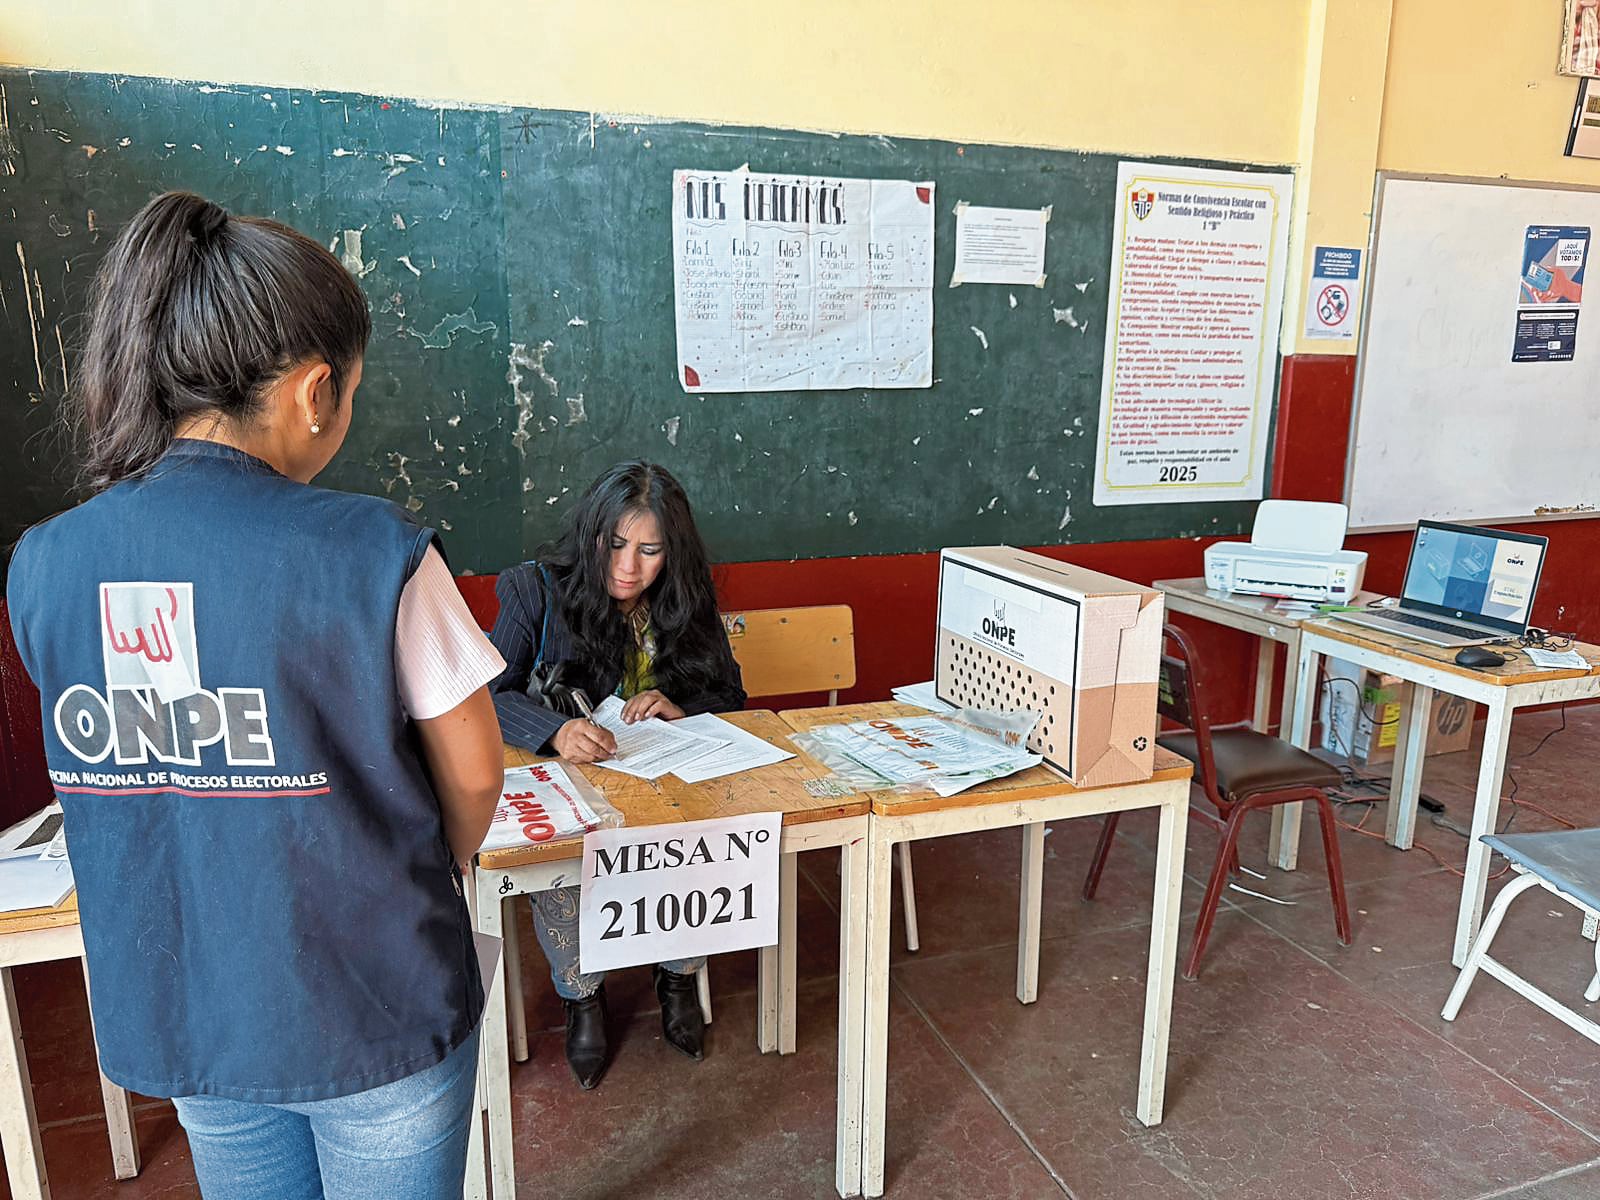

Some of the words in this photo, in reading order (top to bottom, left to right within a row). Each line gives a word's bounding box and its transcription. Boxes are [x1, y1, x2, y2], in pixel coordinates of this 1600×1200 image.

[1157, 191, 1182, 203] Normas
[1183, 193, 1192, 203] de
[1193, 193, 1230, 206] Convivencia
[1231, 196, 1254, 208] Escolar
[1254, 199, 1266, 209] con
[1167, 205, 1191, 216] Sentido
[1158, 465, 1197, 482] 2025
[982, 617, 1016, 647] ONPE
[54, 684, 276, 767] ONPE
[48, 769, 81, 784] FICINA
[82, 771, 146, 787] NACIONAL
[147, 771, 169, 784] DE
[169, 771, 229, 789] PROCESOS
[230, 772, 328, 789] ELECTORALES
[502, 791, 557, 842] ONPE
[591, 836, 716, 879] MESA
[599, 882, 759, 941] 210021
